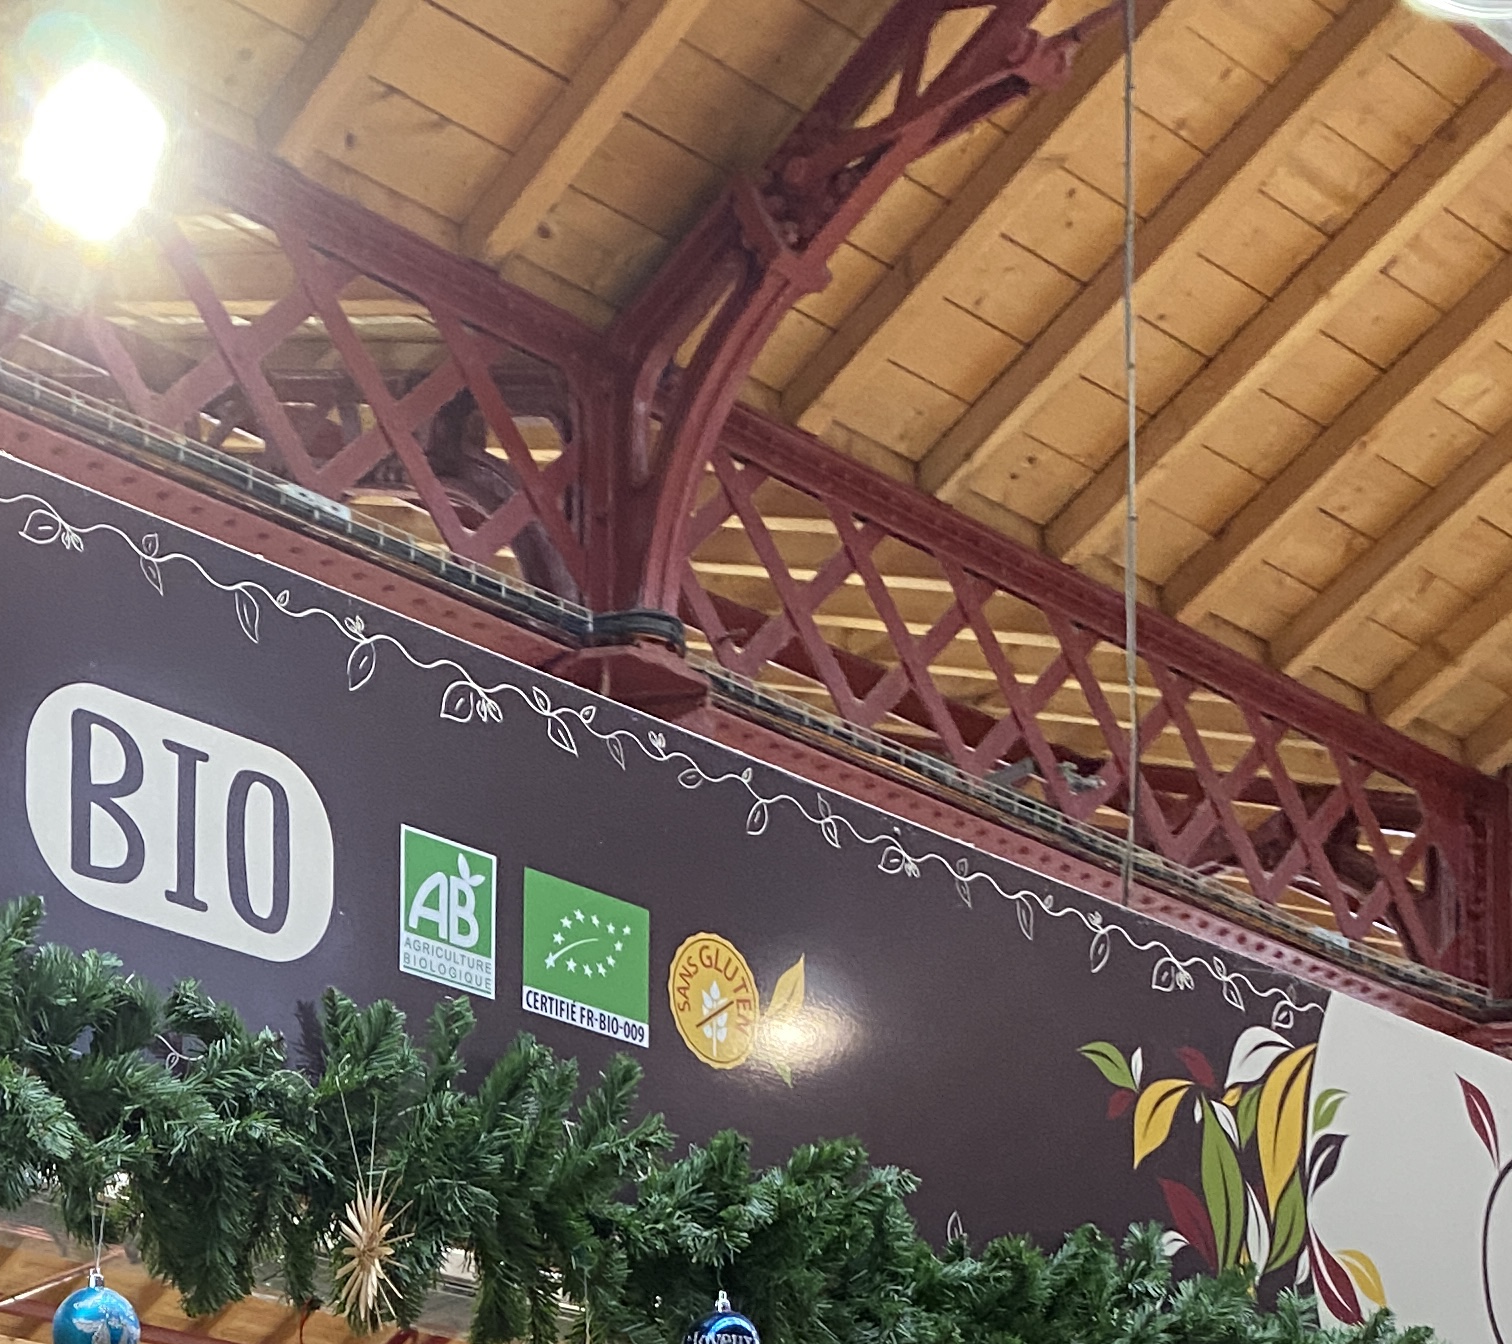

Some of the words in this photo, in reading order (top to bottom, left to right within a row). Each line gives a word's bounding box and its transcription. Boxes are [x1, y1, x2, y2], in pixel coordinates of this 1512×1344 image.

[69, 707, 292, 936] BIO
[408, 870, 480, 948] AB
[402, 952, 492, 991] BIOLOGIQUE
[403, 936, 492, 975] AGRICULTURE
[525, 989, 577, 1022] CERTIFIÉ
[579, 1005, 645, 1044] FR-BIO-009
[677, 960, 700, 1012] SANS
[699, 944, 752, 1035] GLUTEN
